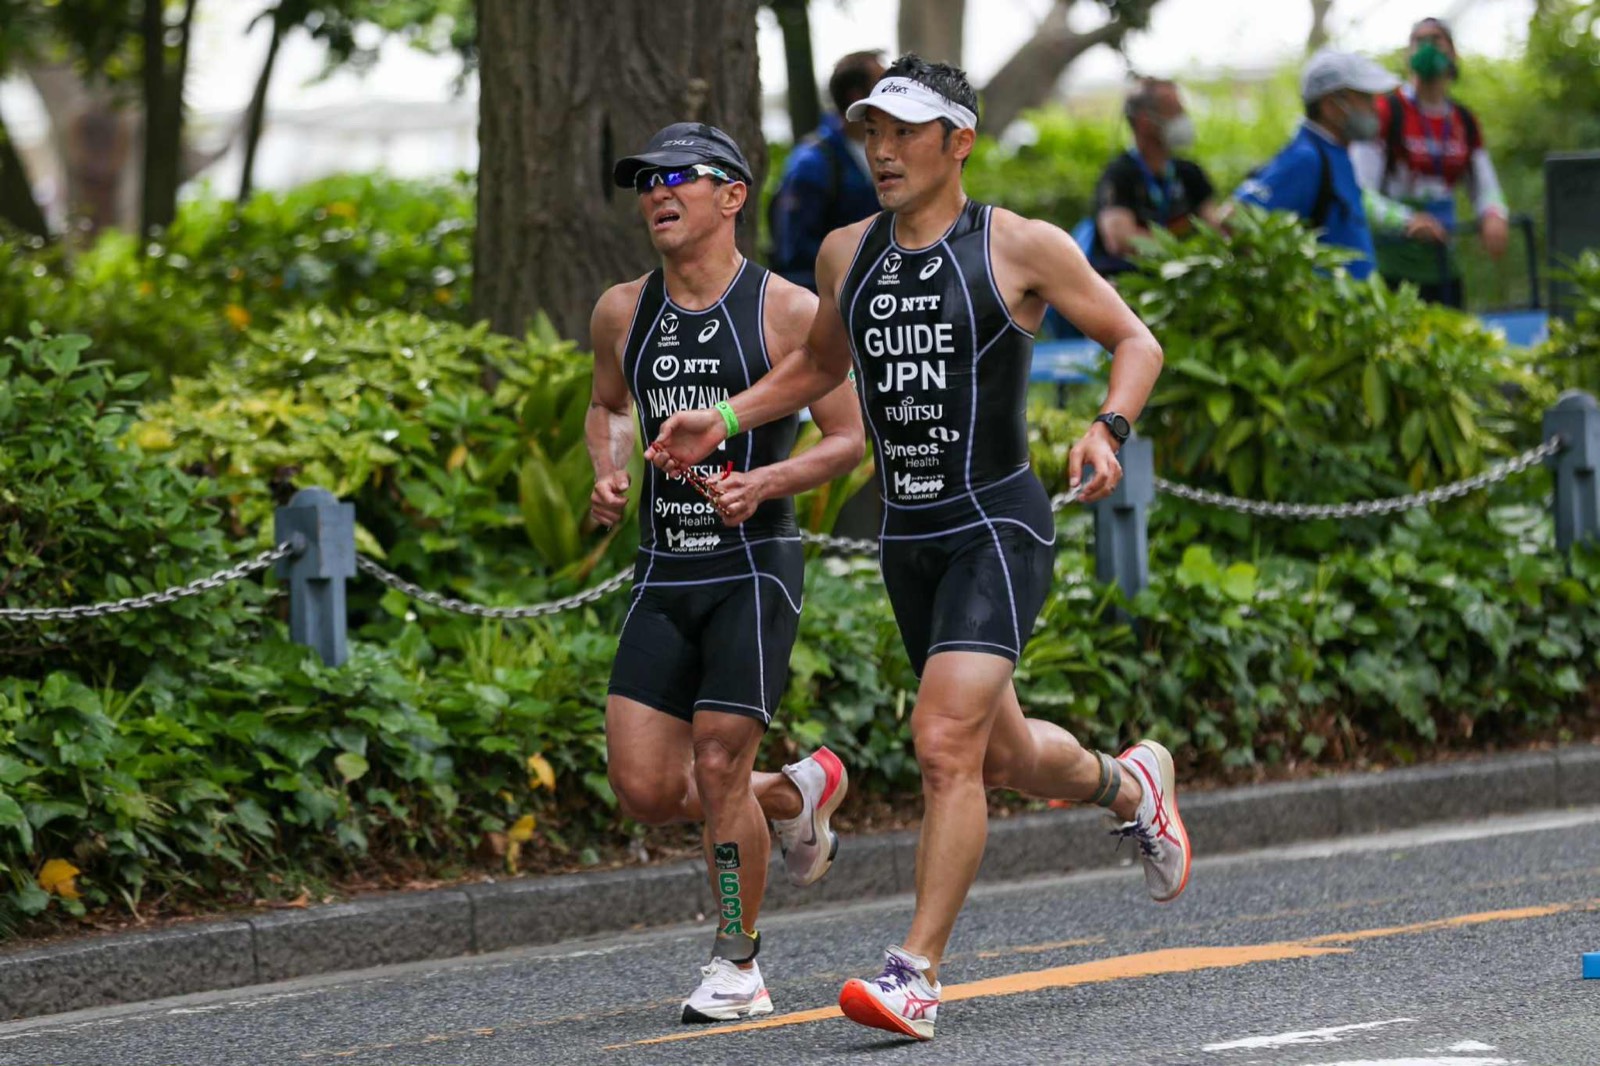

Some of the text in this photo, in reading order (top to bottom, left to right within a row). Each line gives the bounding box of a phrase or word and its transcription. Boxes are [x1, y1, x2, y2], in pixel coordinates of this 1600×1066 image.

[661, 139, 695, 147] 2XU
[901, 295, 941, 312] NTT
[864, 323, 955, 357] GUIDE
[683, 359, 720, 374] NTT
[877, 360, 946, 393] JPN
[884, 400, 943, 426] FUJITSU
[884, 439, 939, 460] Syneos
[905, 456, 940, 468] Health
[655, 498, 714, 517] Syneos
[679, 515, 715, 526] Health
